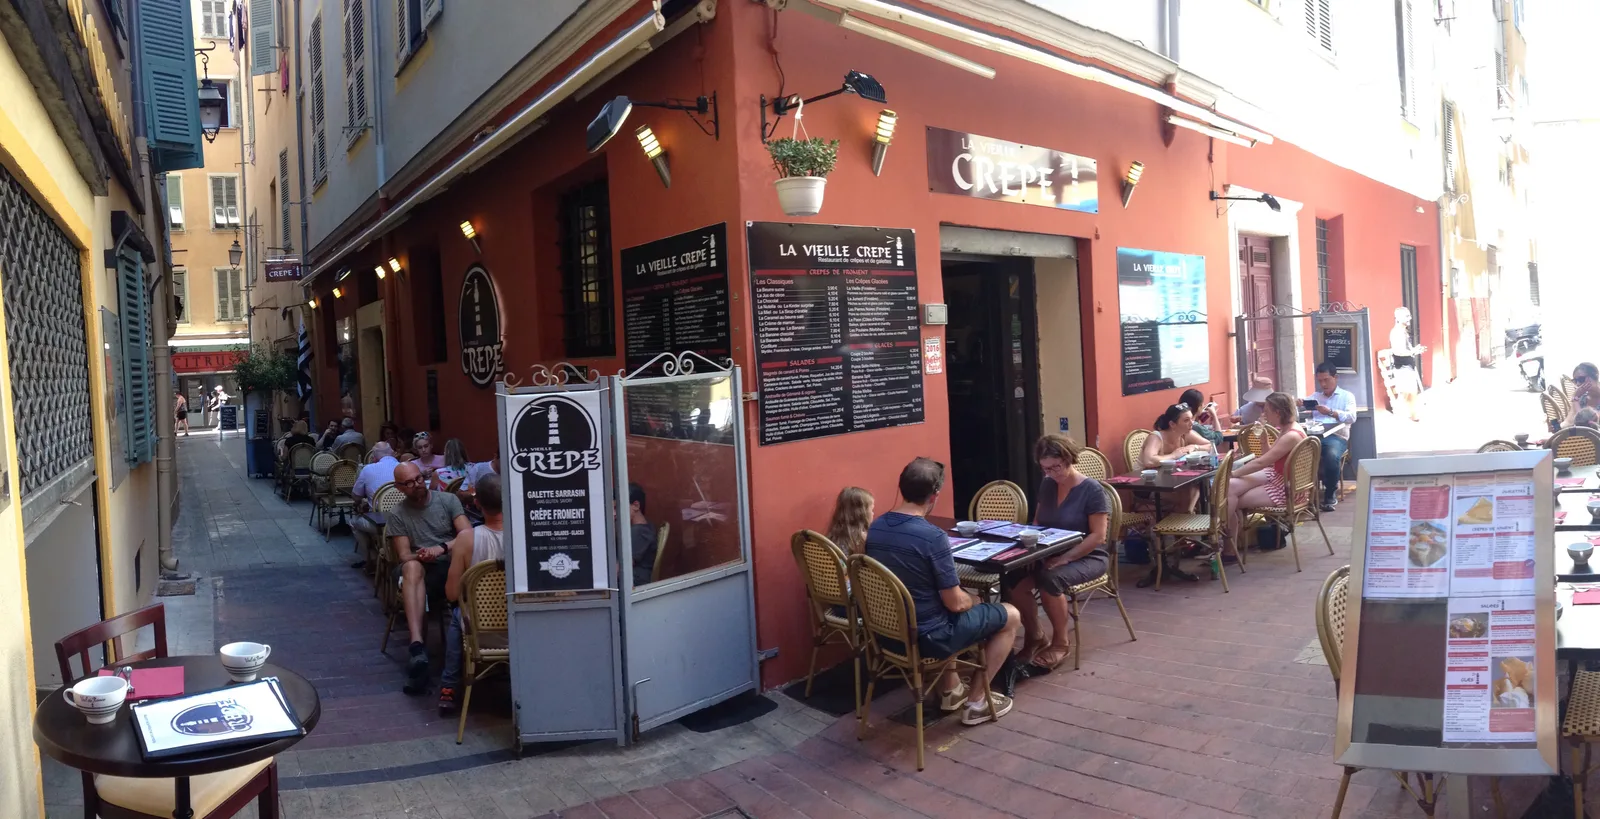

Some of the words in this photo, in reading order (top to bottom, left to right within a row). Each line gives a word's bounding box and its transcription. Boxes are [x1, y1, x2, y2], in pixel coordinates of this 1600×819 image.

[962, 137, 975, 151] LA
[952, 153, 1056, 201] CREPE
[780, 244, 797, 256] LA
[803, 244, 850, 257] VIEILLE
[856, 246, 892, 258] CREPE
[636, 264, 646, 275] LA
[648, 256, 677, 272] VIEILLE
[680, 248, 707, 265] CREPE
[1133, 263, 1142, 272] LA
[173, 356, 234, 368] CITRUS
[462, 344, 504, 374] CREPE
[512, 450, 599, 471] CREPE
[527, 490, 554, 498] GALETTE
[555, 489, 585, 497] SARRASIN
[530, 507, 552, 520] CRÊPE
[553, 508, 585, 519] FROMENT
[216, 698, 254, 732] CREPE
